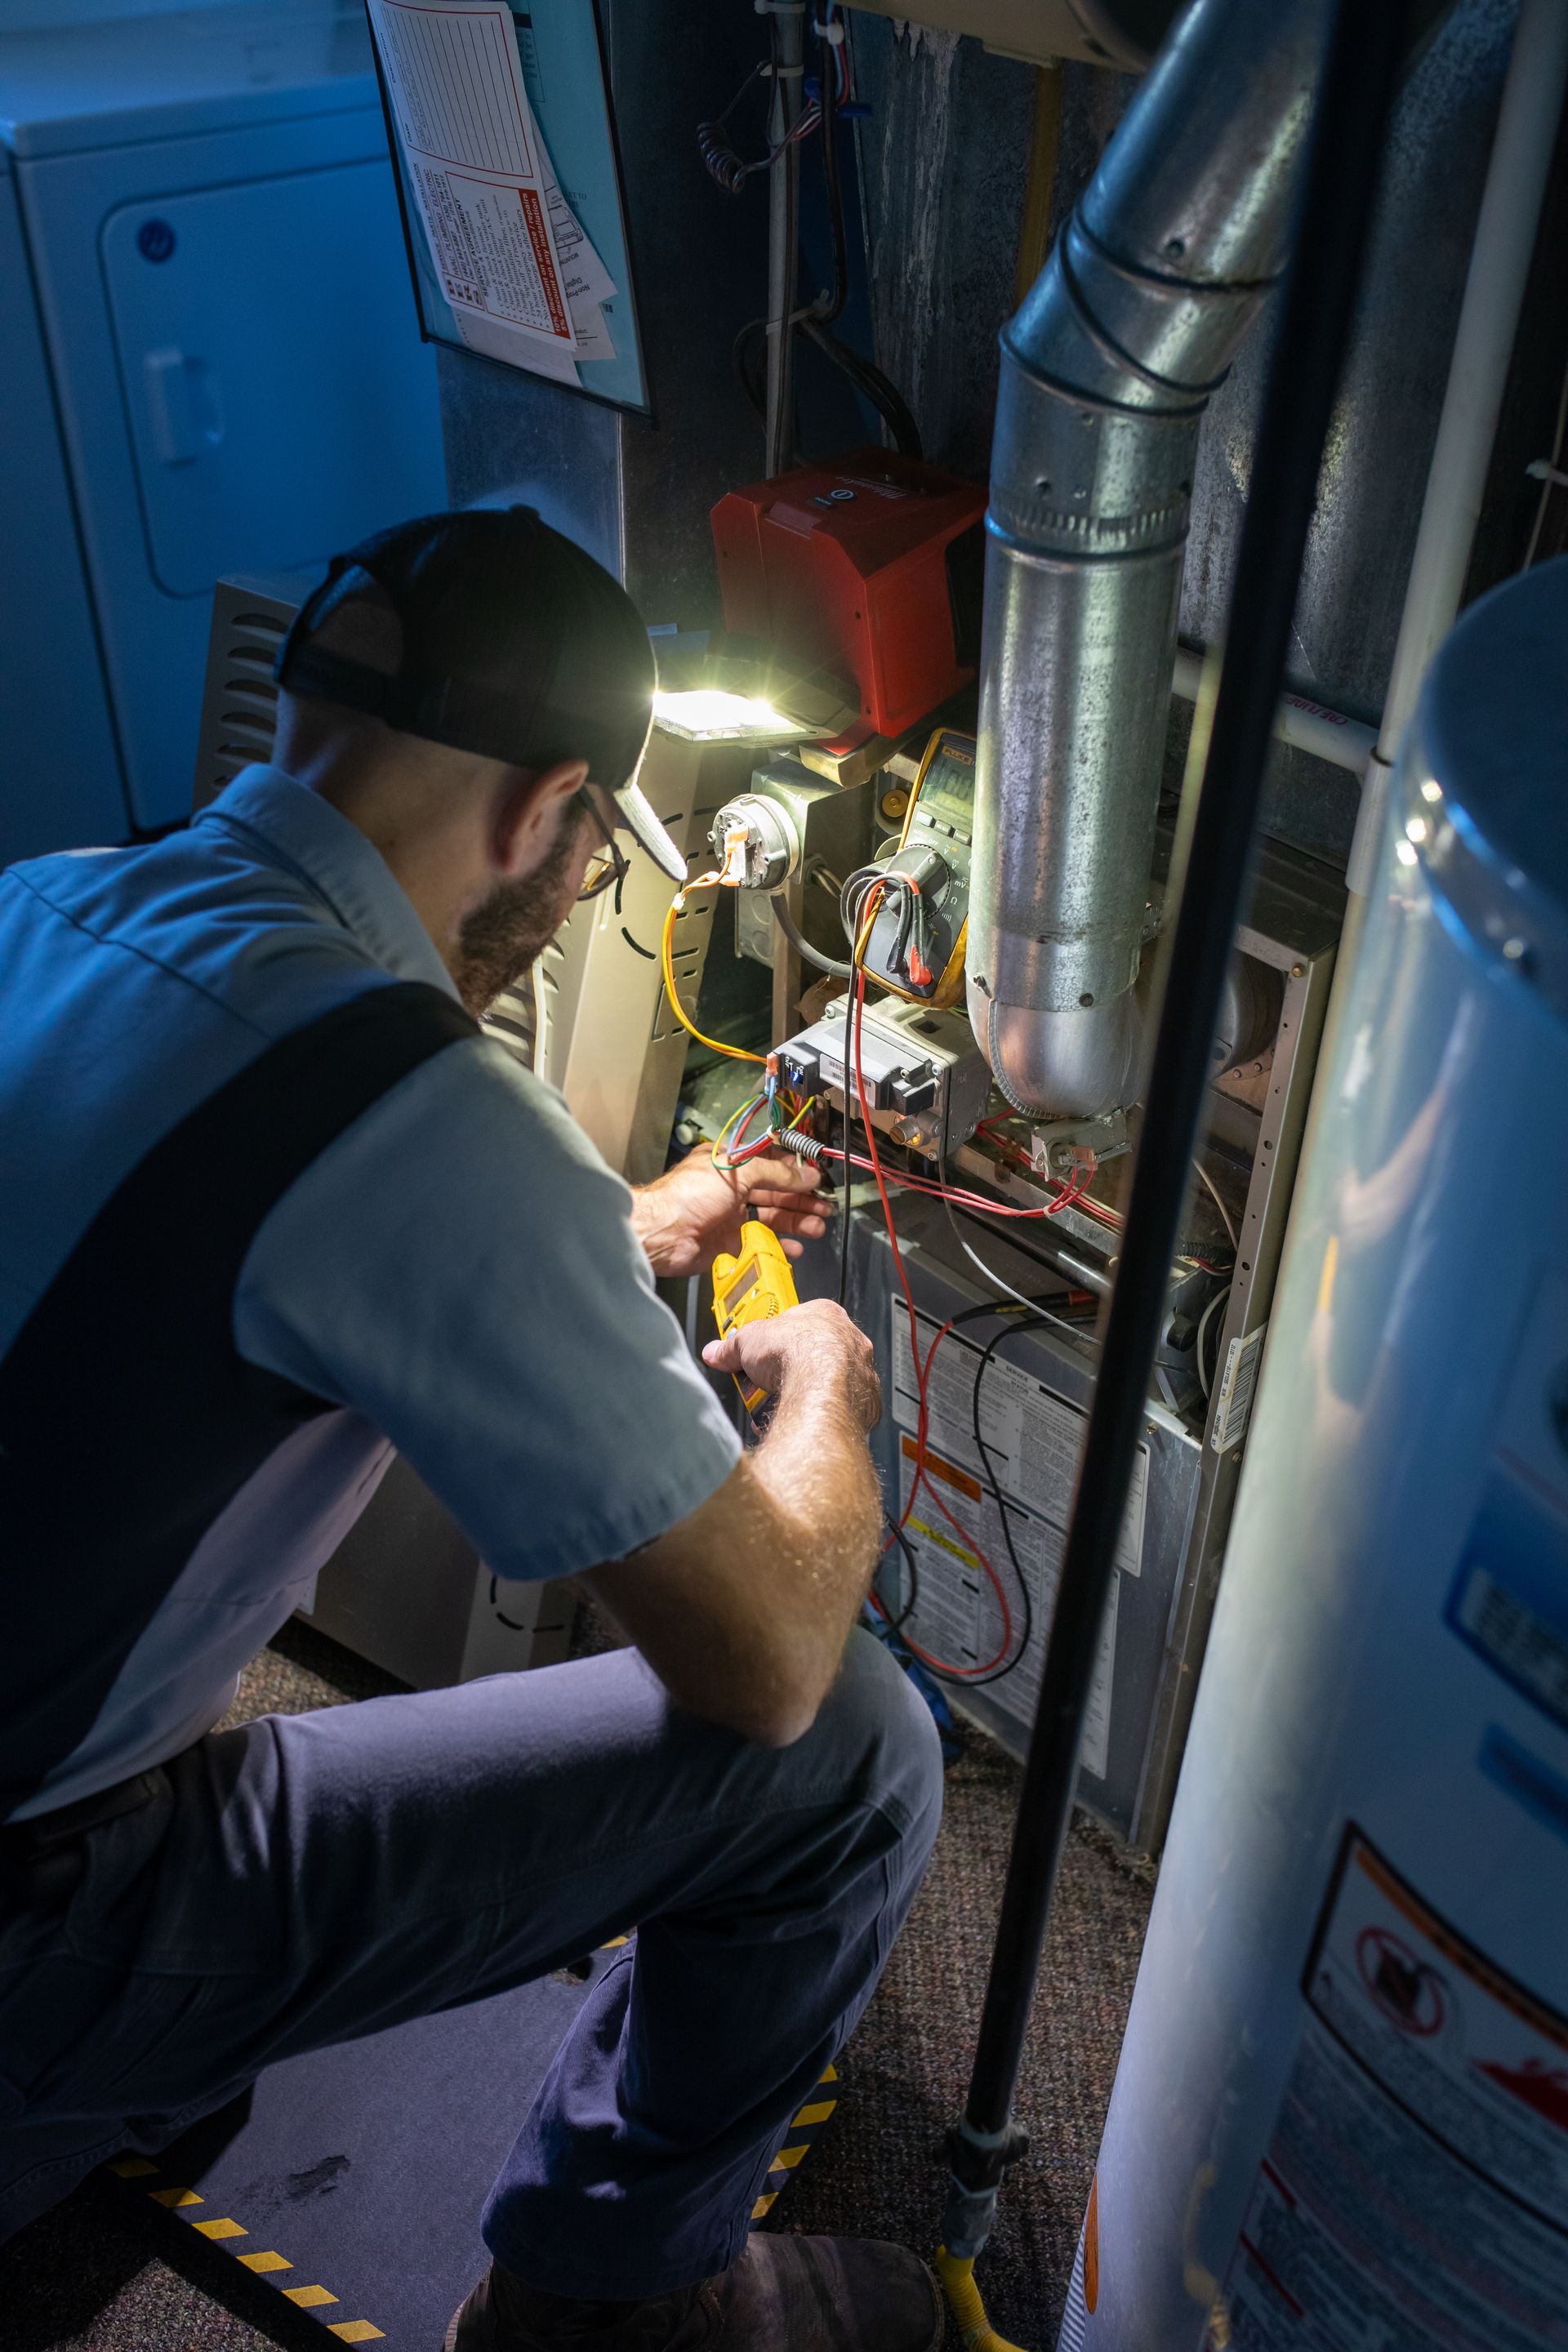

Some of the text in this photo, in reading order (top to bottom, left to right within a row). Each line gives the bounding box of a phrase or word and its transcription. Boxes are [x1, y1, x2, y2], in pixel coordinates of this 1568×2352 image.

[945, 748, 970, 763] FLUKE
[928, 838, 939, 847] OFF
[954, 880, 966, 889] mV
